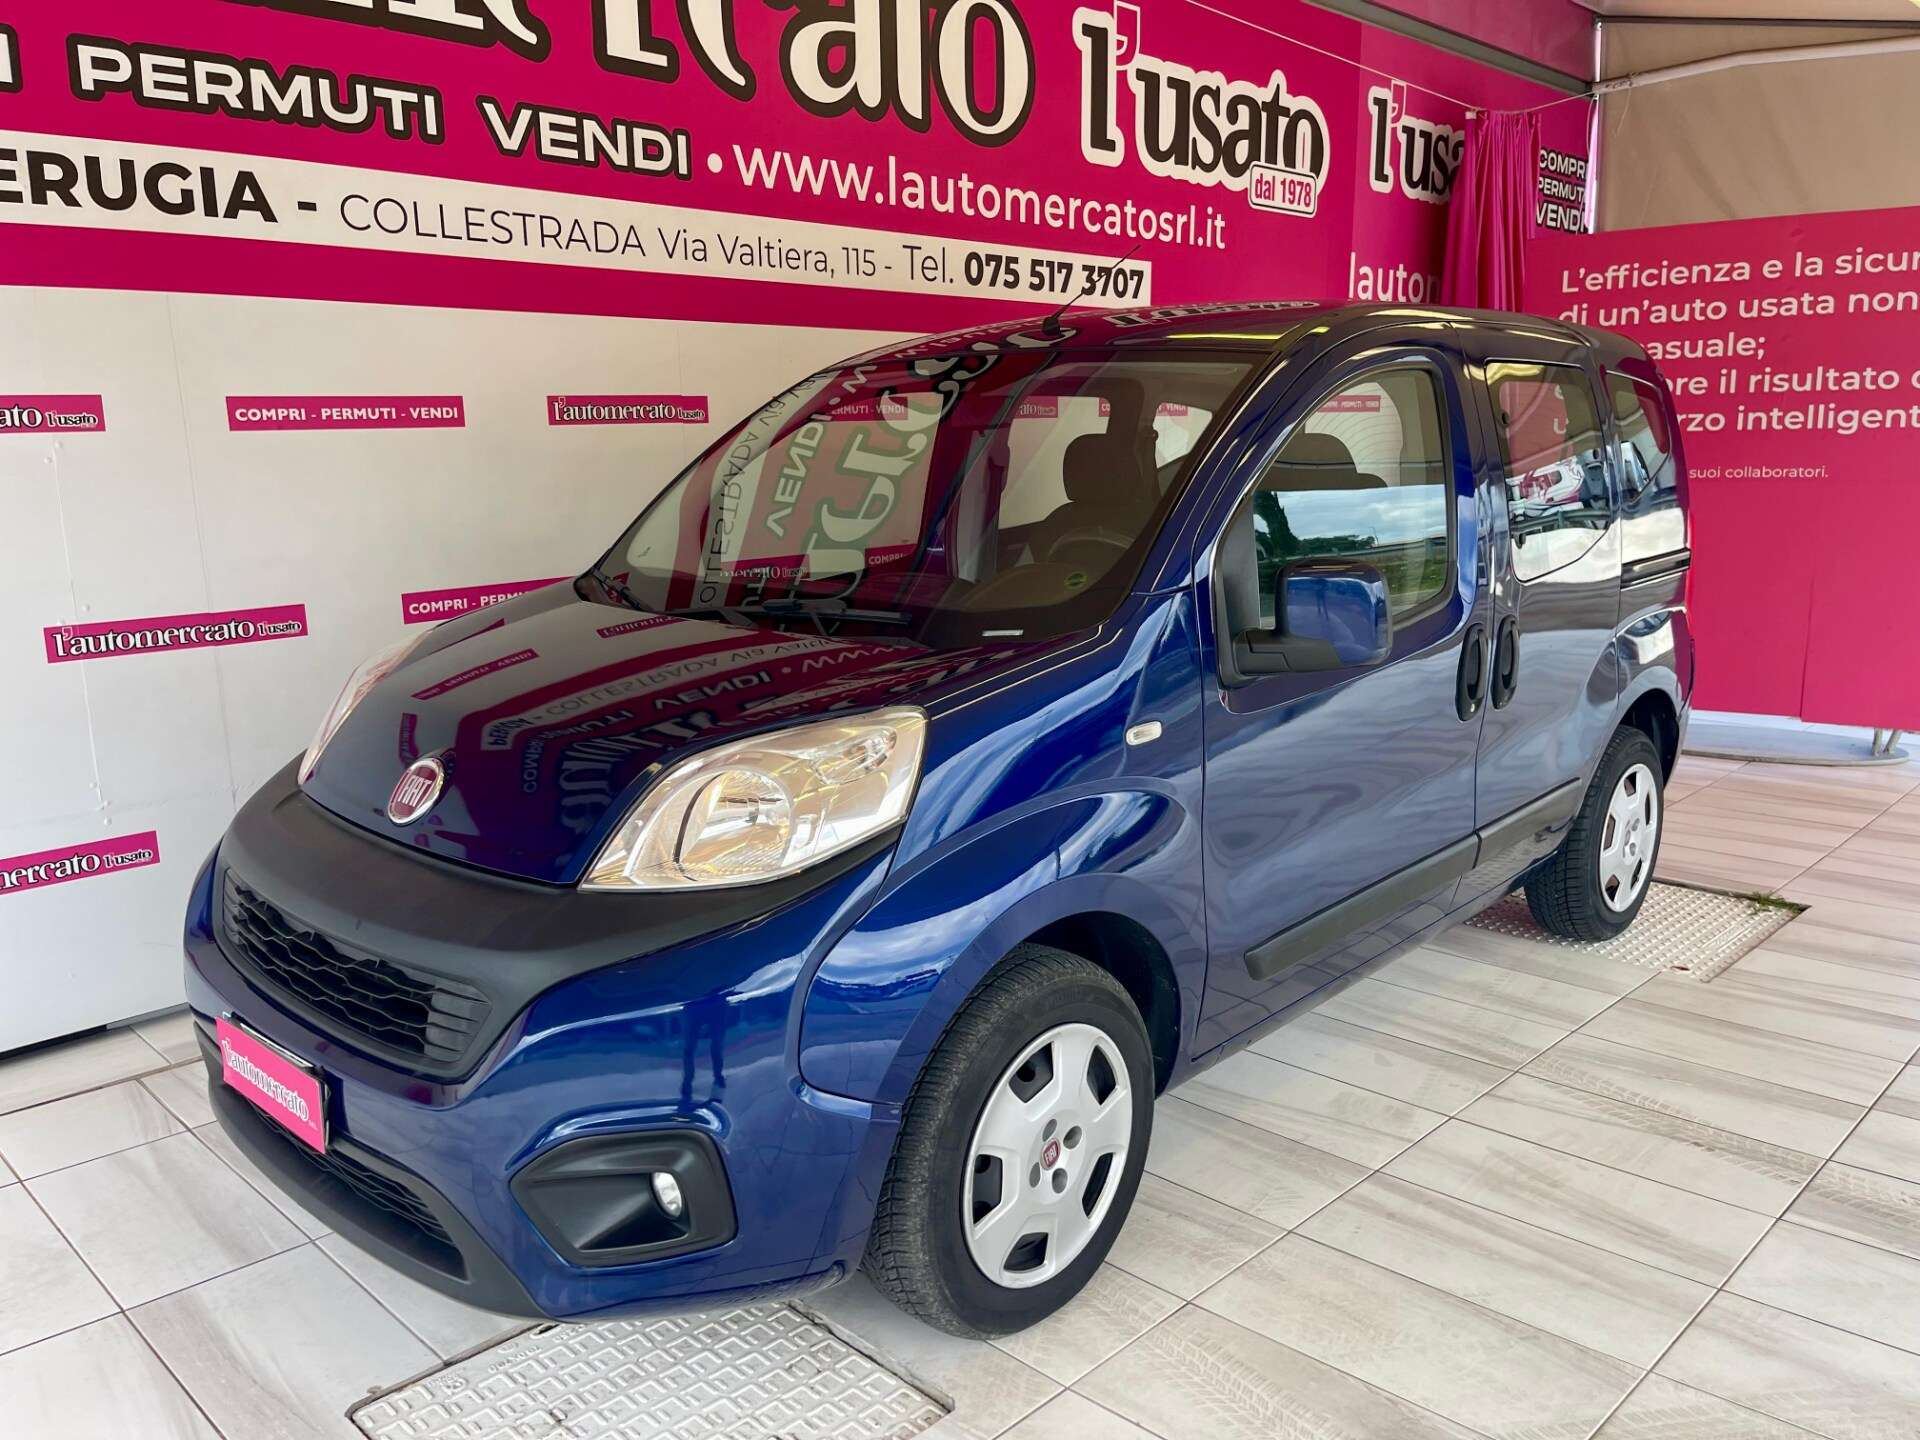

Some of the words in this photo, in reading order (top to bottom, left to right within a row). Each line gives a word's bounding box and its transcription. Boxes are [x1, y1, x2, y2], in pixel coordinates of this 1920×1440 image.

[1076, 1, 1326, 182] l'usato
[77, 44, 438, 136] PERMUTI
[482, 102, 688, 175] VENDI
[732, 144, 1226, 250] www.lautomercatosrl.it
[1540, 150, 1586, 179] COMPR
[1255, 174, 1275, 201] dal
[1281, 178, 1312, 208] 1978
[1538, 177, 1585, 202] PERMUT
[340, 194, 646, 257] COLLESTRADA
[658, 227, 708, 262] Via
[717, 233, 835, 278] Valtiera,
[842, 246, 876, 277] 115
[902, 244, 954, 284] Tel.
[964, 251, 1020, 290] 075
[1028, 258, 1073, 294] 517
[1081, 264, 1144, 299] 3707
[1561, 260, 1751, 294] L'efficienza
[1762, 258, 1783, 279] e
[1794, 251, 1823, 277] la
[1598, 297, 1727, 327] un'auto
[1738, 291, 1835, 319] usata
[1847, 290, 1918, 313] non
[1640, 331, 1767, 360] asuale;
[1720, 368, 1737, 394] il
[1748, 366, 1899, 393] risultato
[235, 408, 306, 421] COMPRI
[321, 407, 396, 420] PERMUTI
[409, 407, 458, 419] VENDI
[553, 397, 676, 421] l'automercato
[1736, 404, 1920, 435] intelligent
[1689, 466, 1721, 478] suoi
[1725, 465, 1829, 479] collaboratori.
[409, 598, 467, 615] COMPRI
[397, 774, 433, 808] FIAT
